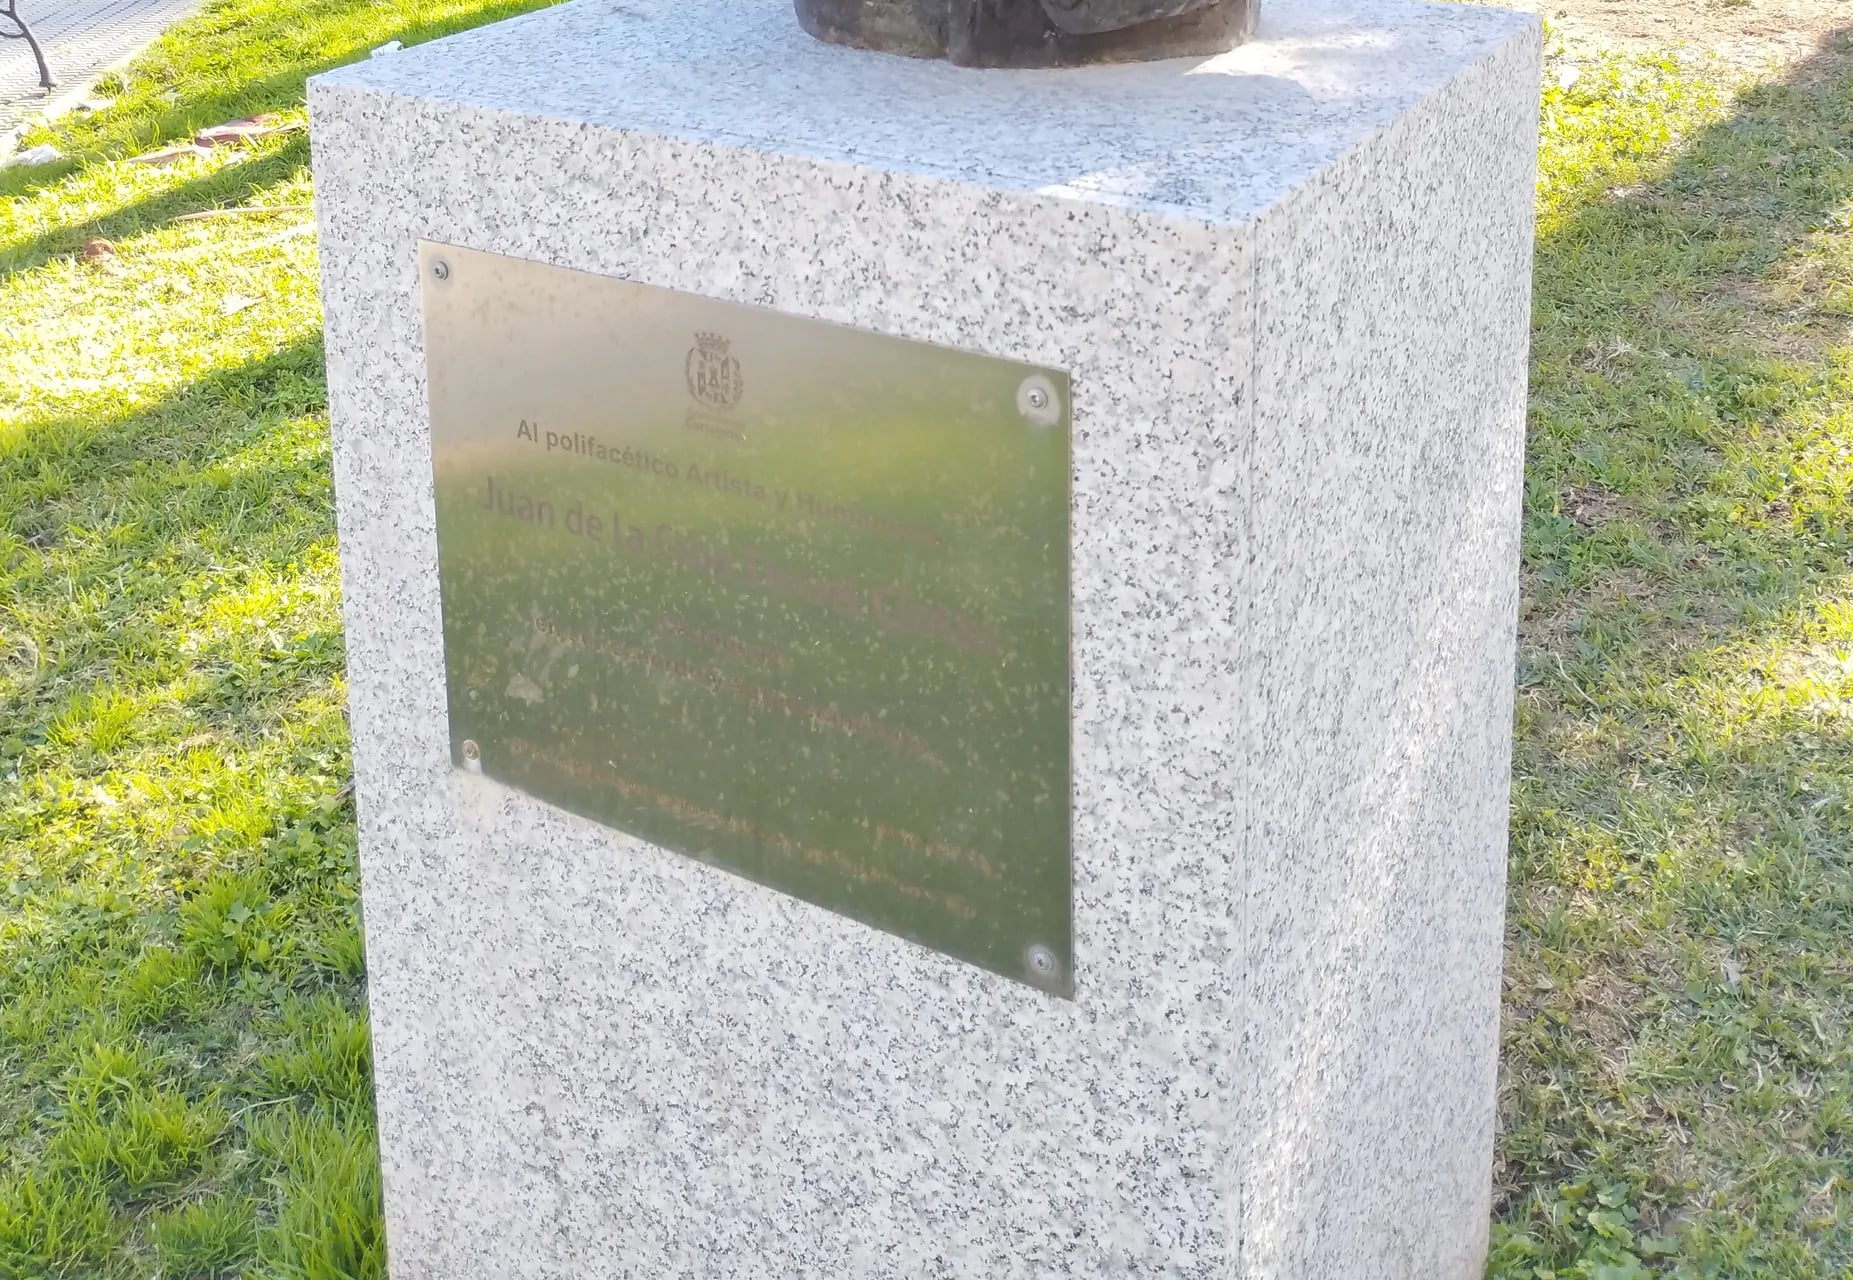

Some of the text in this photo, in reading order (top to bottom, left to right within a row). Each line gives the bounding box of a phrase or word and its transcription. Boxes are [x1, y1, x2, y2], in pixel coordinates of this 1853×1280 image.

[517, 419, 538, 443] Al
[546, 430, 679, 479] polifacético
[687, 463, 768, 501] Artista
[482, 476, 554, 528] Juan
[565, 499, 602, 542] de
[612, 511, 644, 553] la
